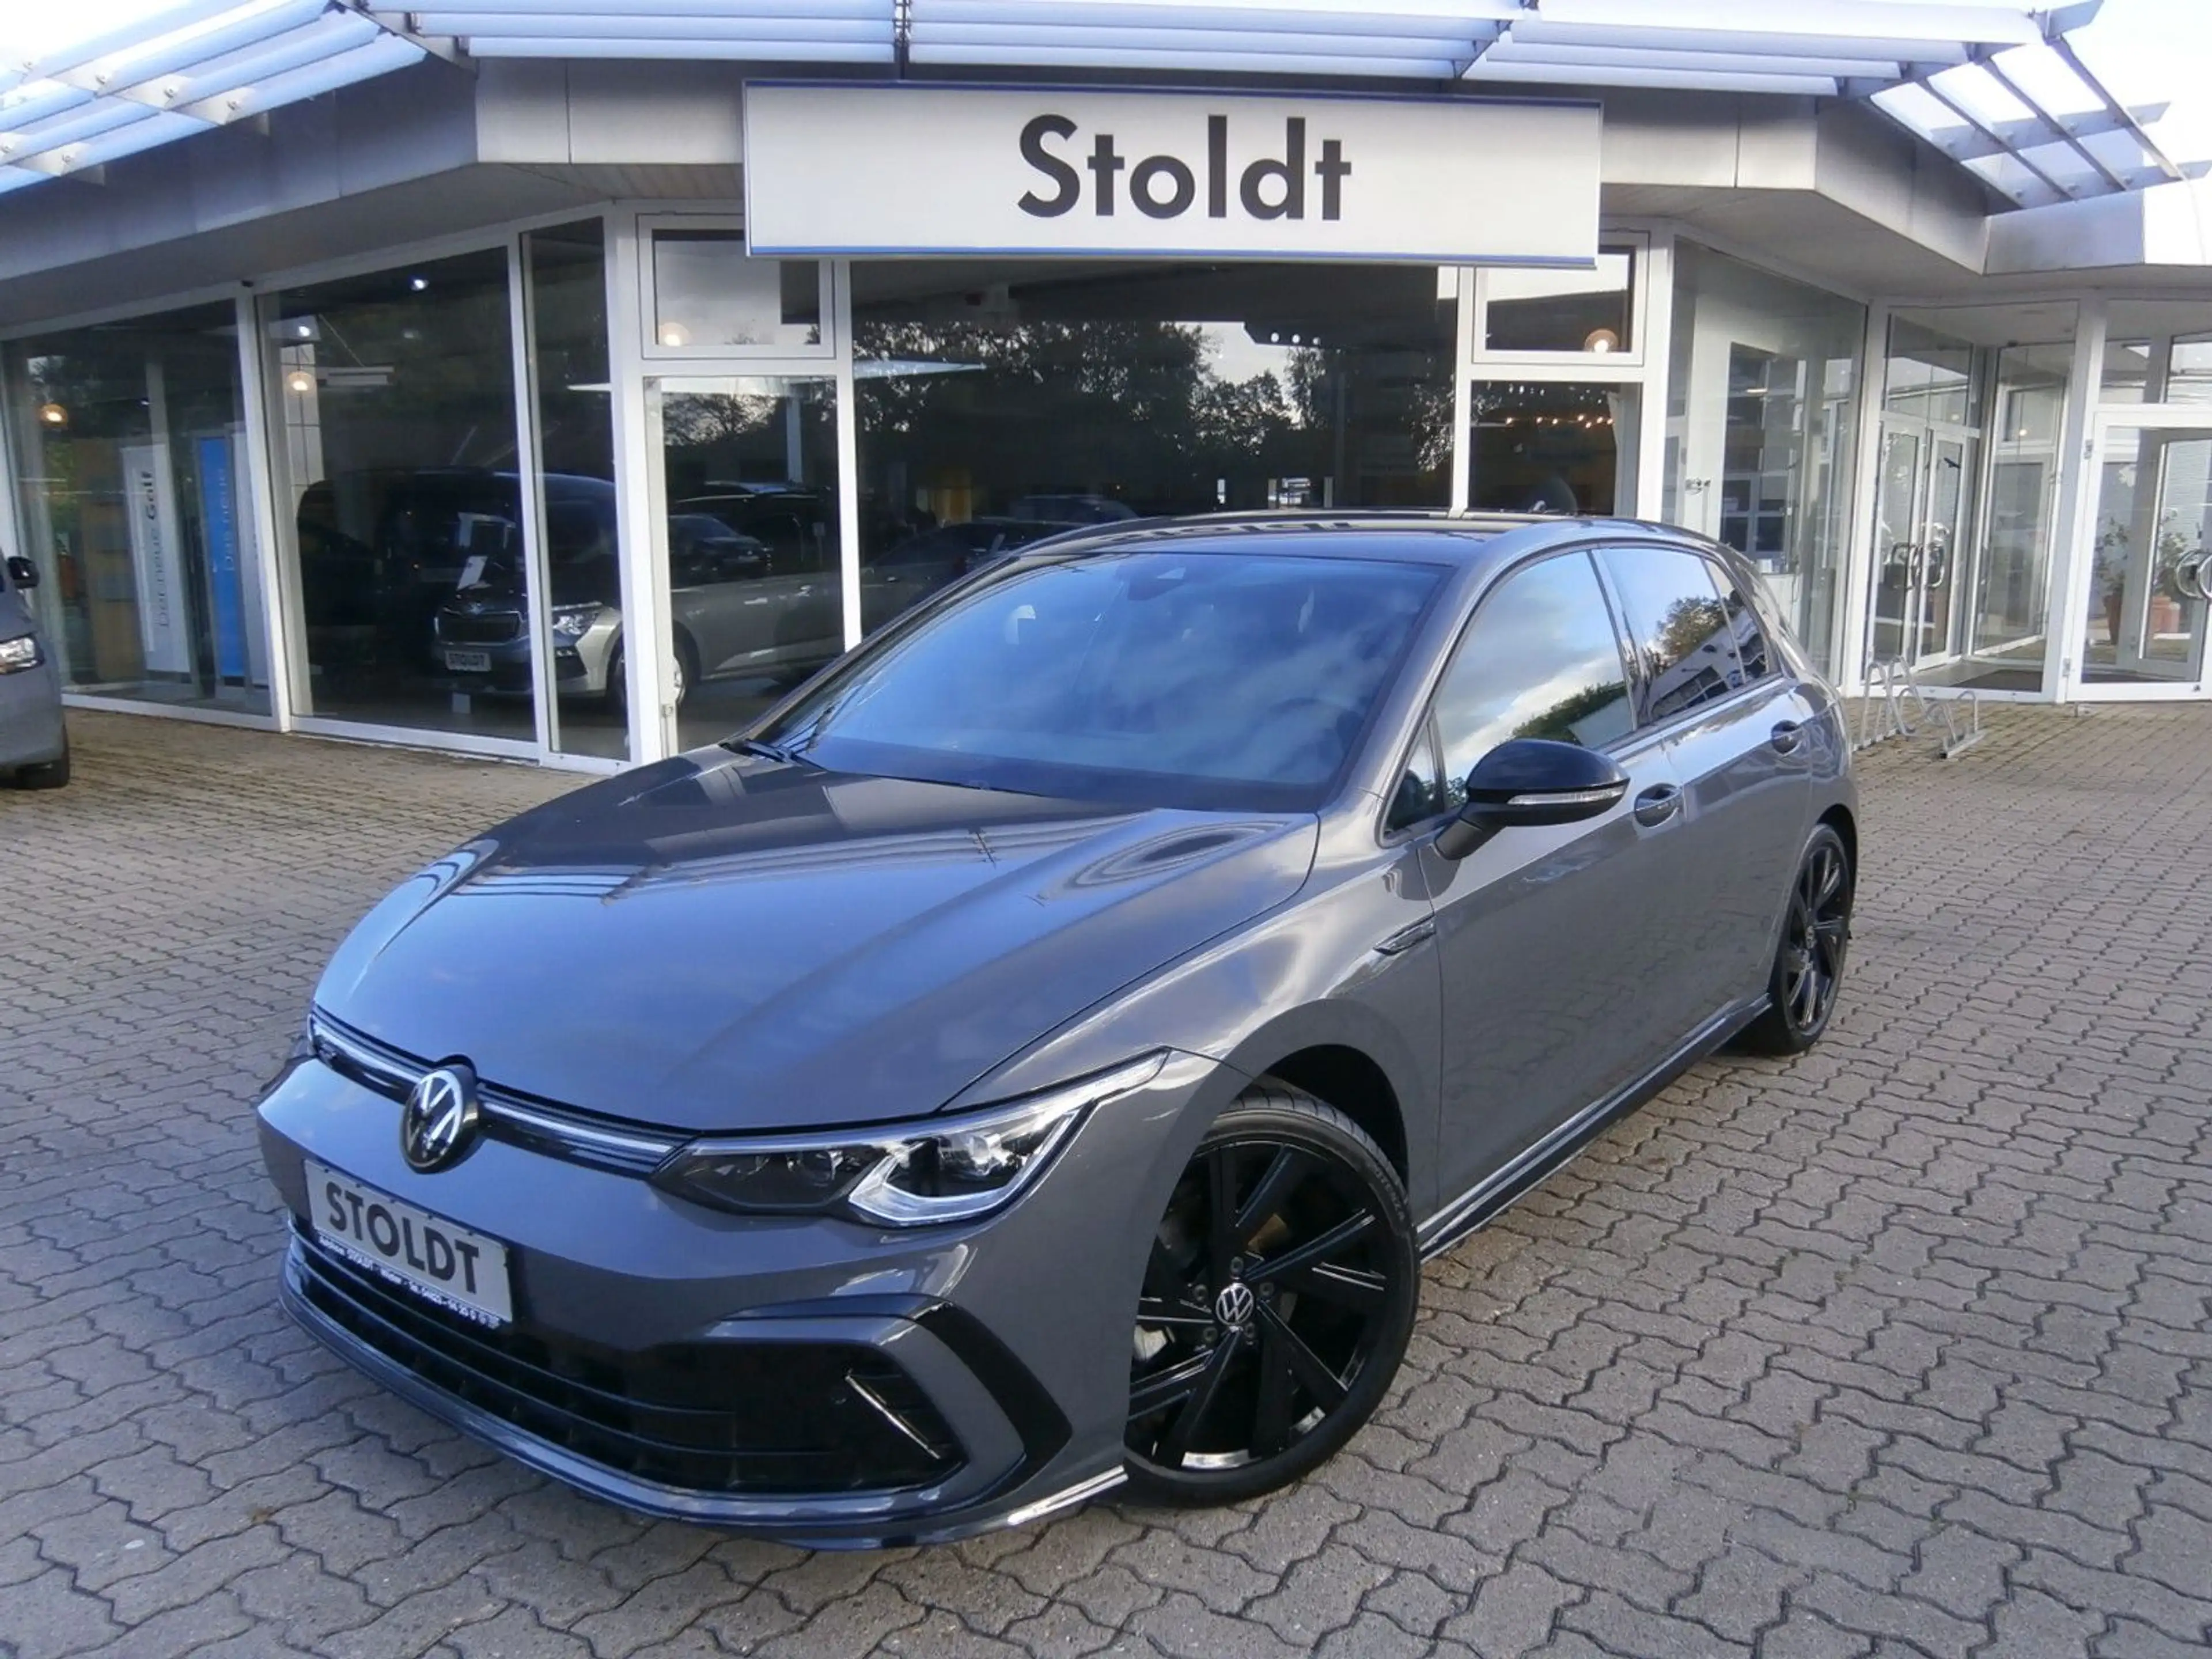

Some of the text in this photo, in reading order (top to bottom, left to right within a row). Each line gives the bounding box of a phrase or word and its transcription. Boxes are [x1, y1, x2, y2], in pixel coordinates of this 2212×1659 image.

[1017, 114, 1351, 220] Stoldt
[141, 471, 157, 521] Golf
[326, 1181, 479, 1294] STOLDT
